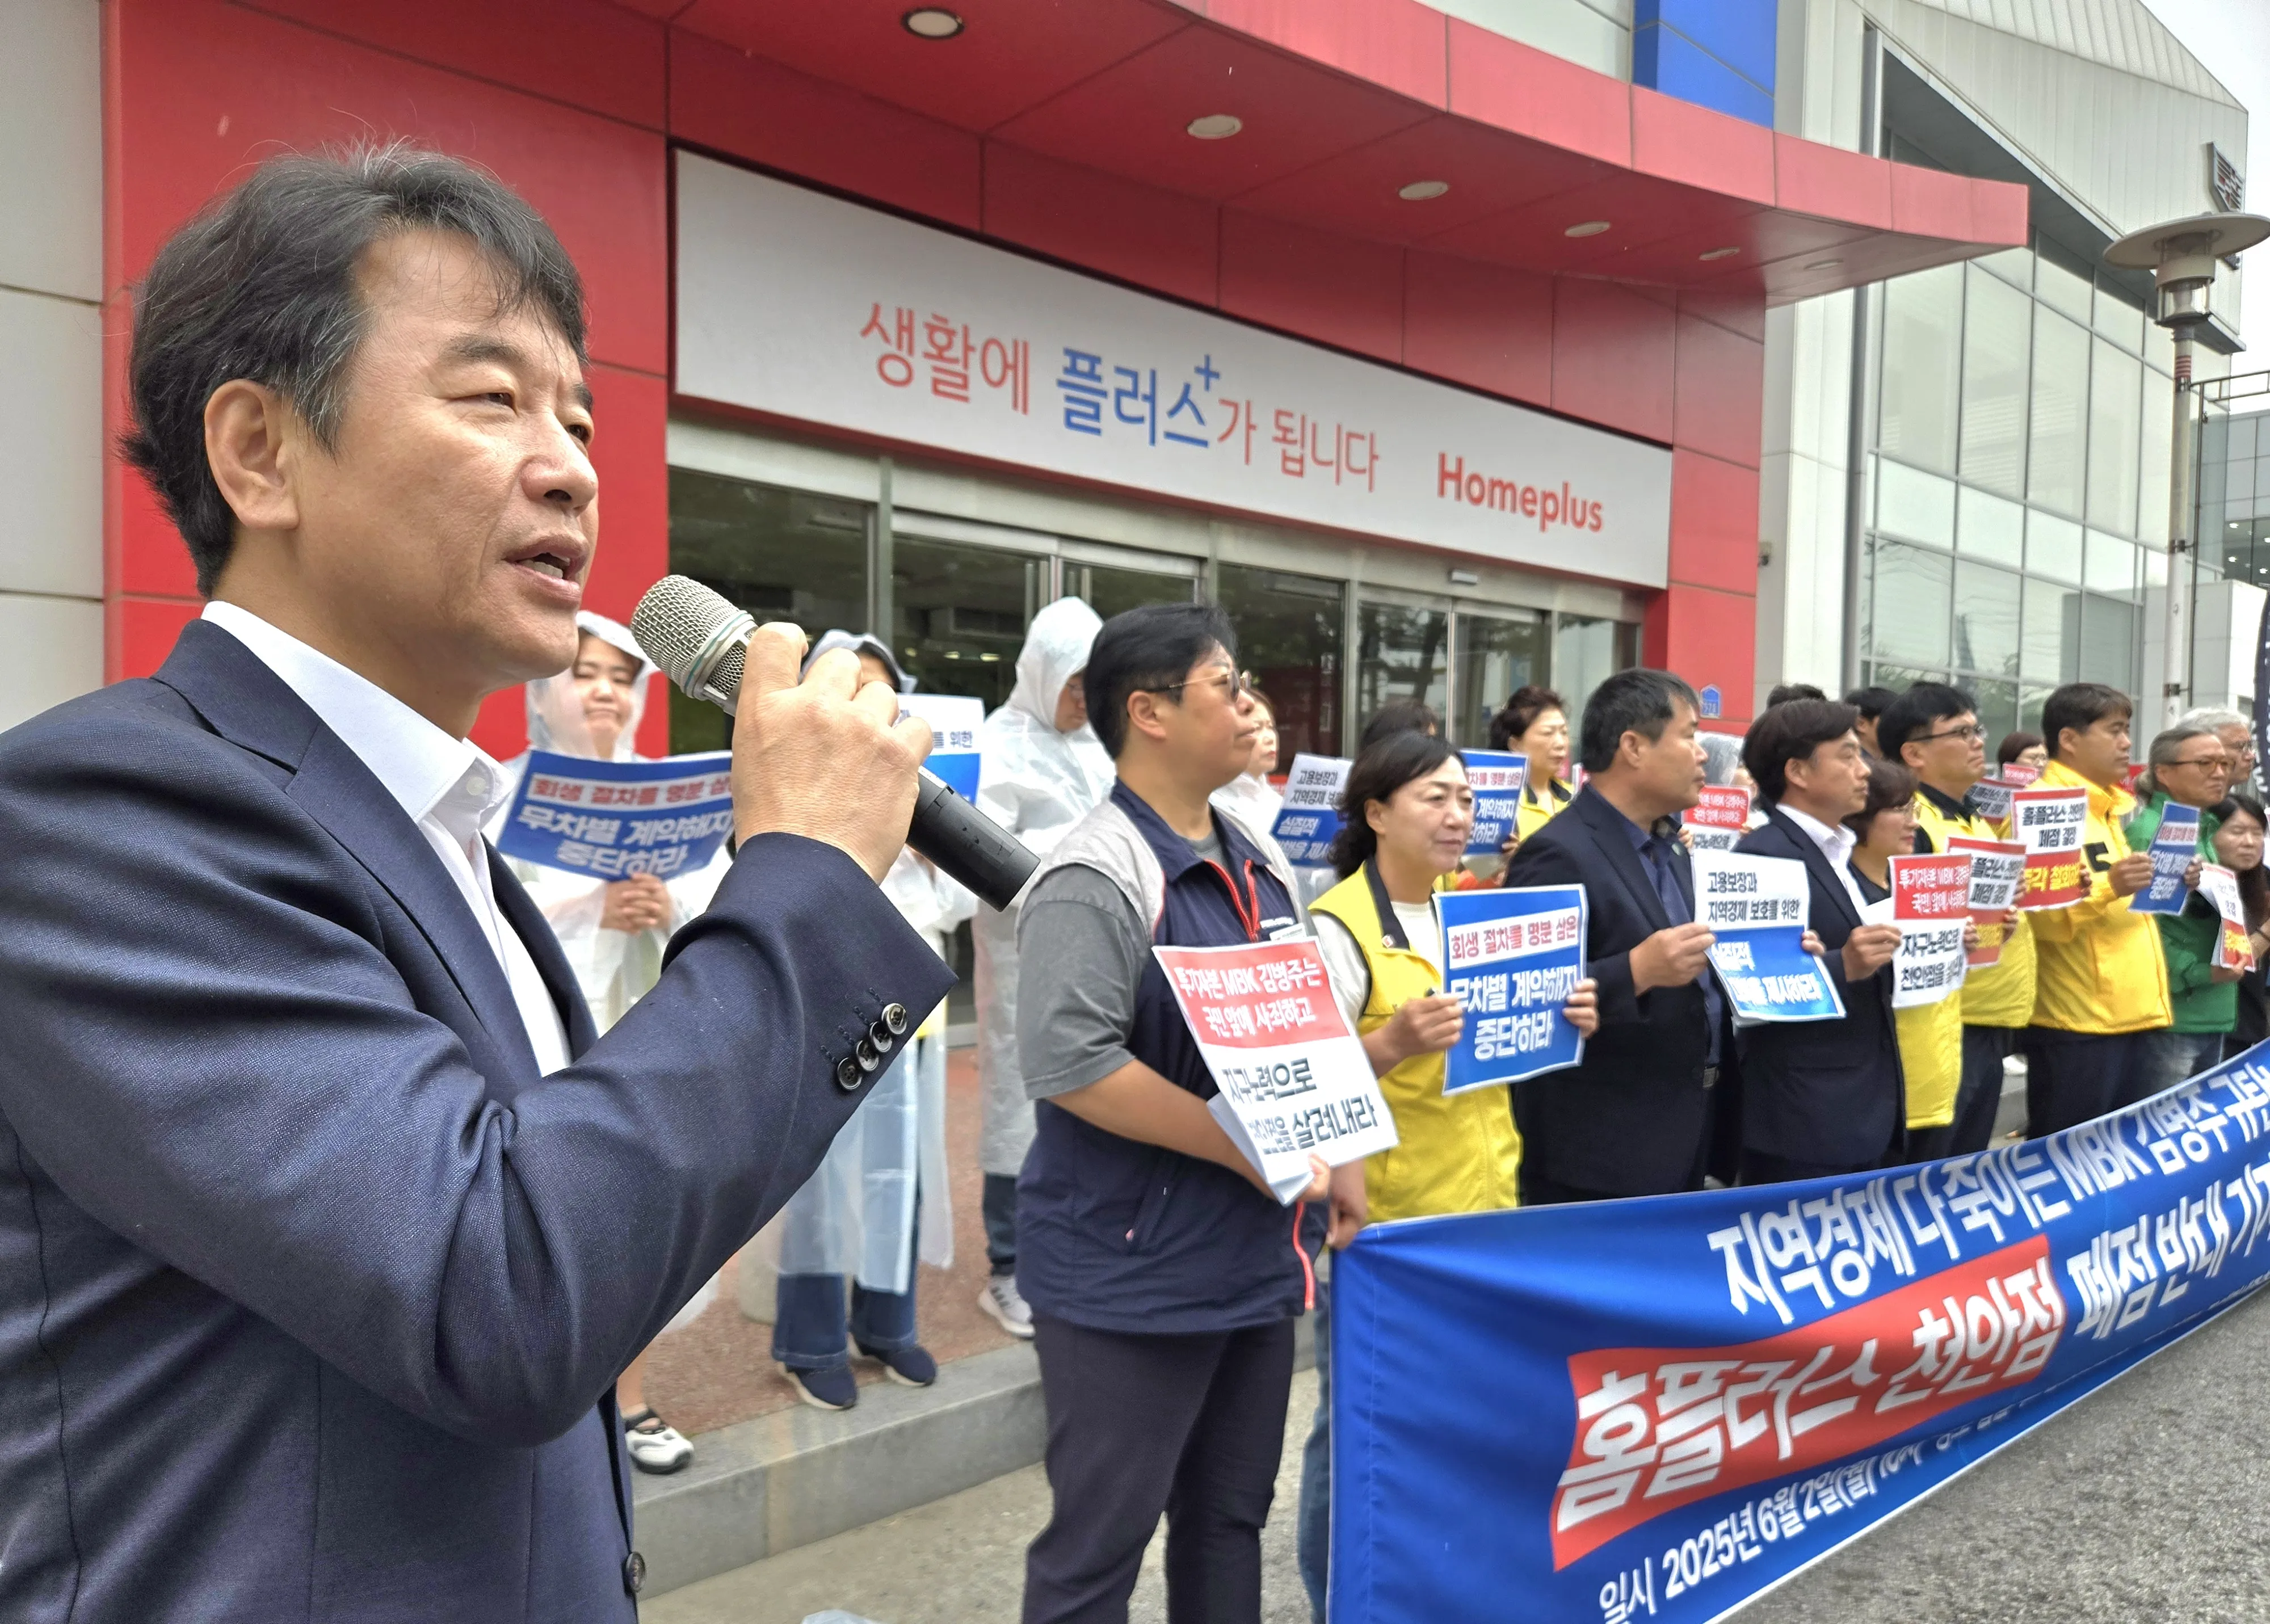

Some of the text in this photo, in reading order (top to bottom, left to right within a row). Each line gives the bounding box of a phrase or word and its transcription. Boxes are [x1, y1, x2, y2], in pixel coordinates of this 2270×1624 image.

[860, 302, 1029, 415] 생활에
[1272, 407, 1379, 493] 됩니다
[1437, 451, 1603, 533] Homeplus
[949, 730, 973, 748] 위한
[1289, 788, 1327, 805] 지역경제
[1297, 770, 1338, 786] 고용보장과
[1468, 771, 1487, 786] 차를
[517, 803, 623, 845] 무차별
[2022, 803, 2067, 826] 홈플러스
[2038, 827, 2061, 848] 폐점
[556, 838, 689, 877] 중단하라
[1971, 856, 2006, 880] 플러스
[1707, 871, 1757, 893] 고용보장과
[1708, 898, 1801, 923] 지역경제 보호를 위한
[1451, 931, 1479, 960] 회생
[1483, 924, 1522, 955] 절차를
[1528, 920, 1552, 946] 명분
[1220, 966, 1262, 998] MBK
[1256, 958, 1322, 994] 김병주는
[1450, 964, 1578, 1014] 무차별 계약해지
[1253, 997, 1318, 1033] 사죄하고
[1474, 1008, 1554, 1062] 중단하라
[1292, 1093, 1379, 1150] 살려내라
[1706, 1176, 1917, 1326] 지역경제
[2045, 1116, 2153, 1201] MBK
[2125, 1084, 2230, 1176] 김병주
[1556, 1337, 1885, 1534] 홈플러스
[1874, 1252, 2066, 1416] 천안점
[2066, 1213, 2158, 1341] 폐점
[2155, 1179, 2230, 1307] 반대
[1599, 1556, 1658, 1624] 일시
[1662, 1500, 1763, 1601] 2025년
